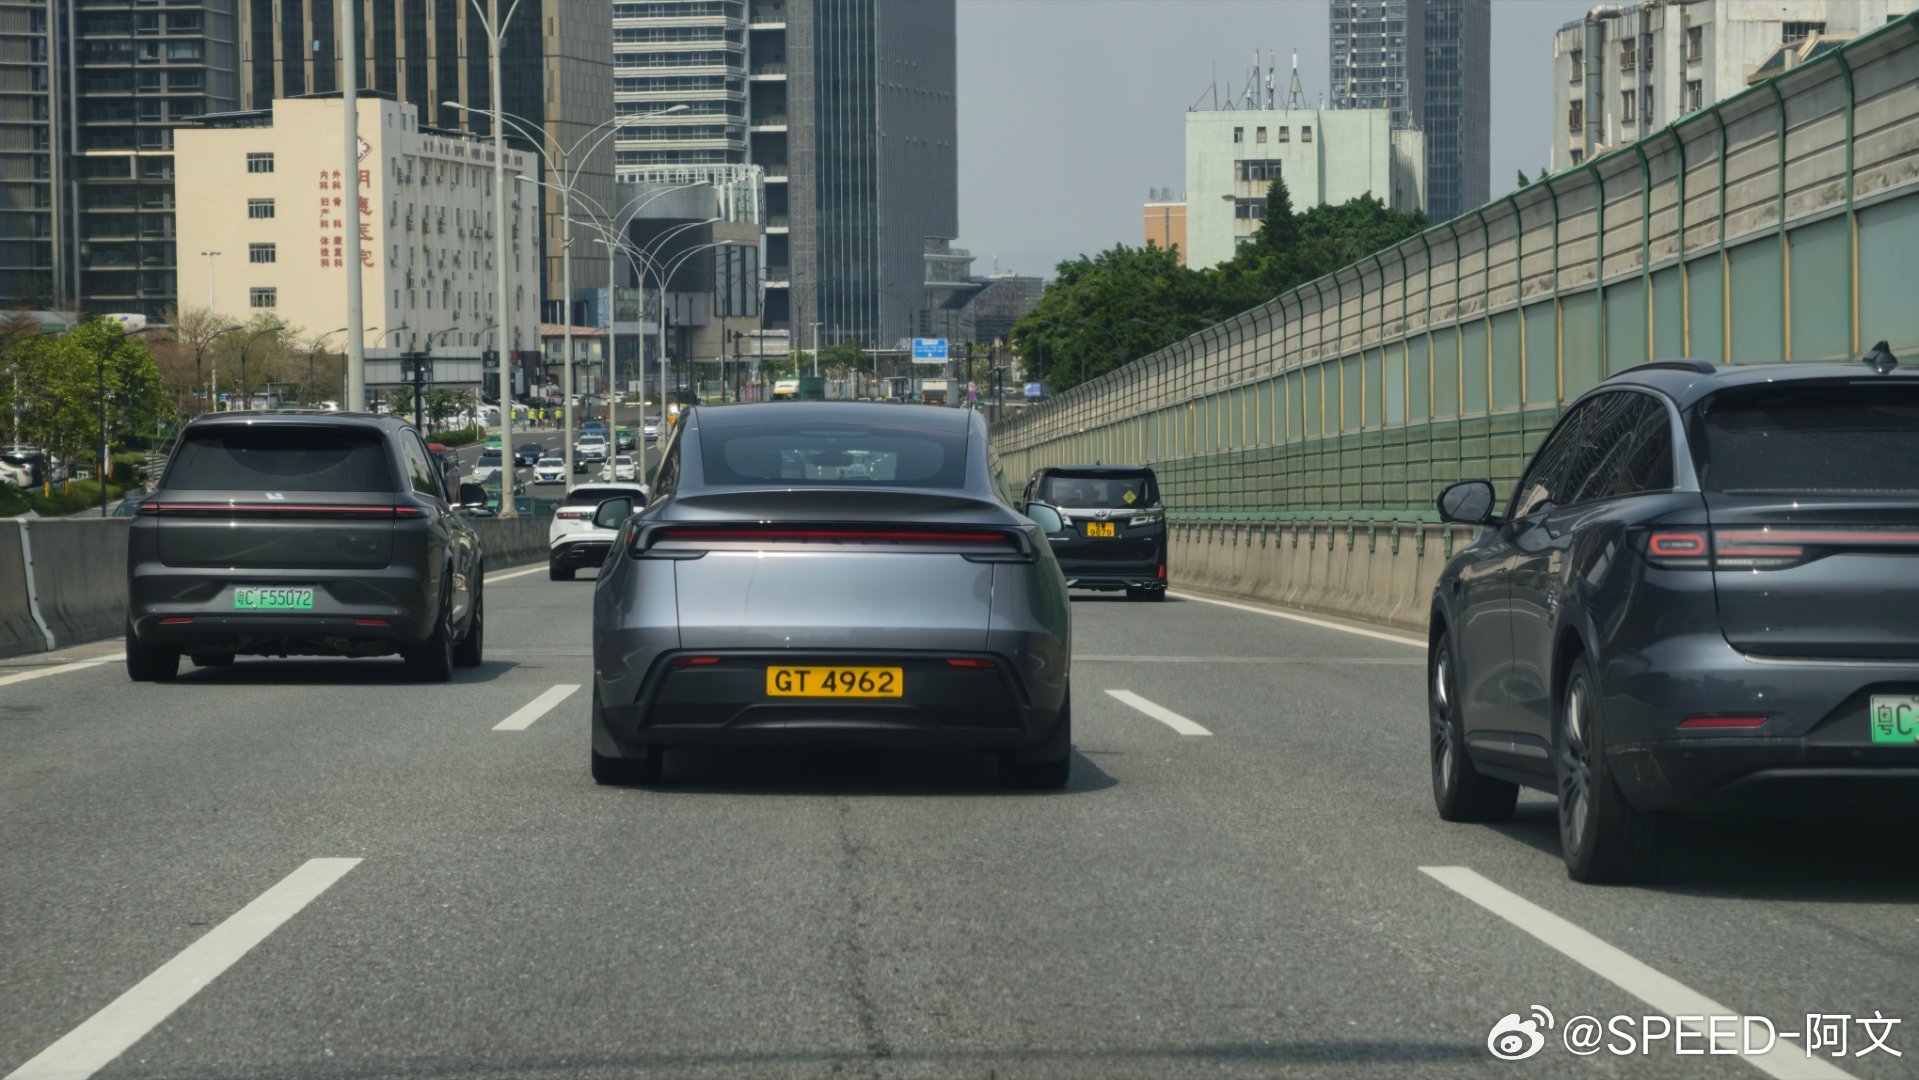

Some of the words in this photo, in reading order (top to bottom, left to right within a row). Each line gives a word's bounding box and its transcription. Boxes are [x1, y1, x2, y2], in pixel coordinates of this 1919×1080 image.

[260, 590, 311, 606] F55072
[775, 670, 811, 692] GT
[821, 670, 894, 693] 4962
